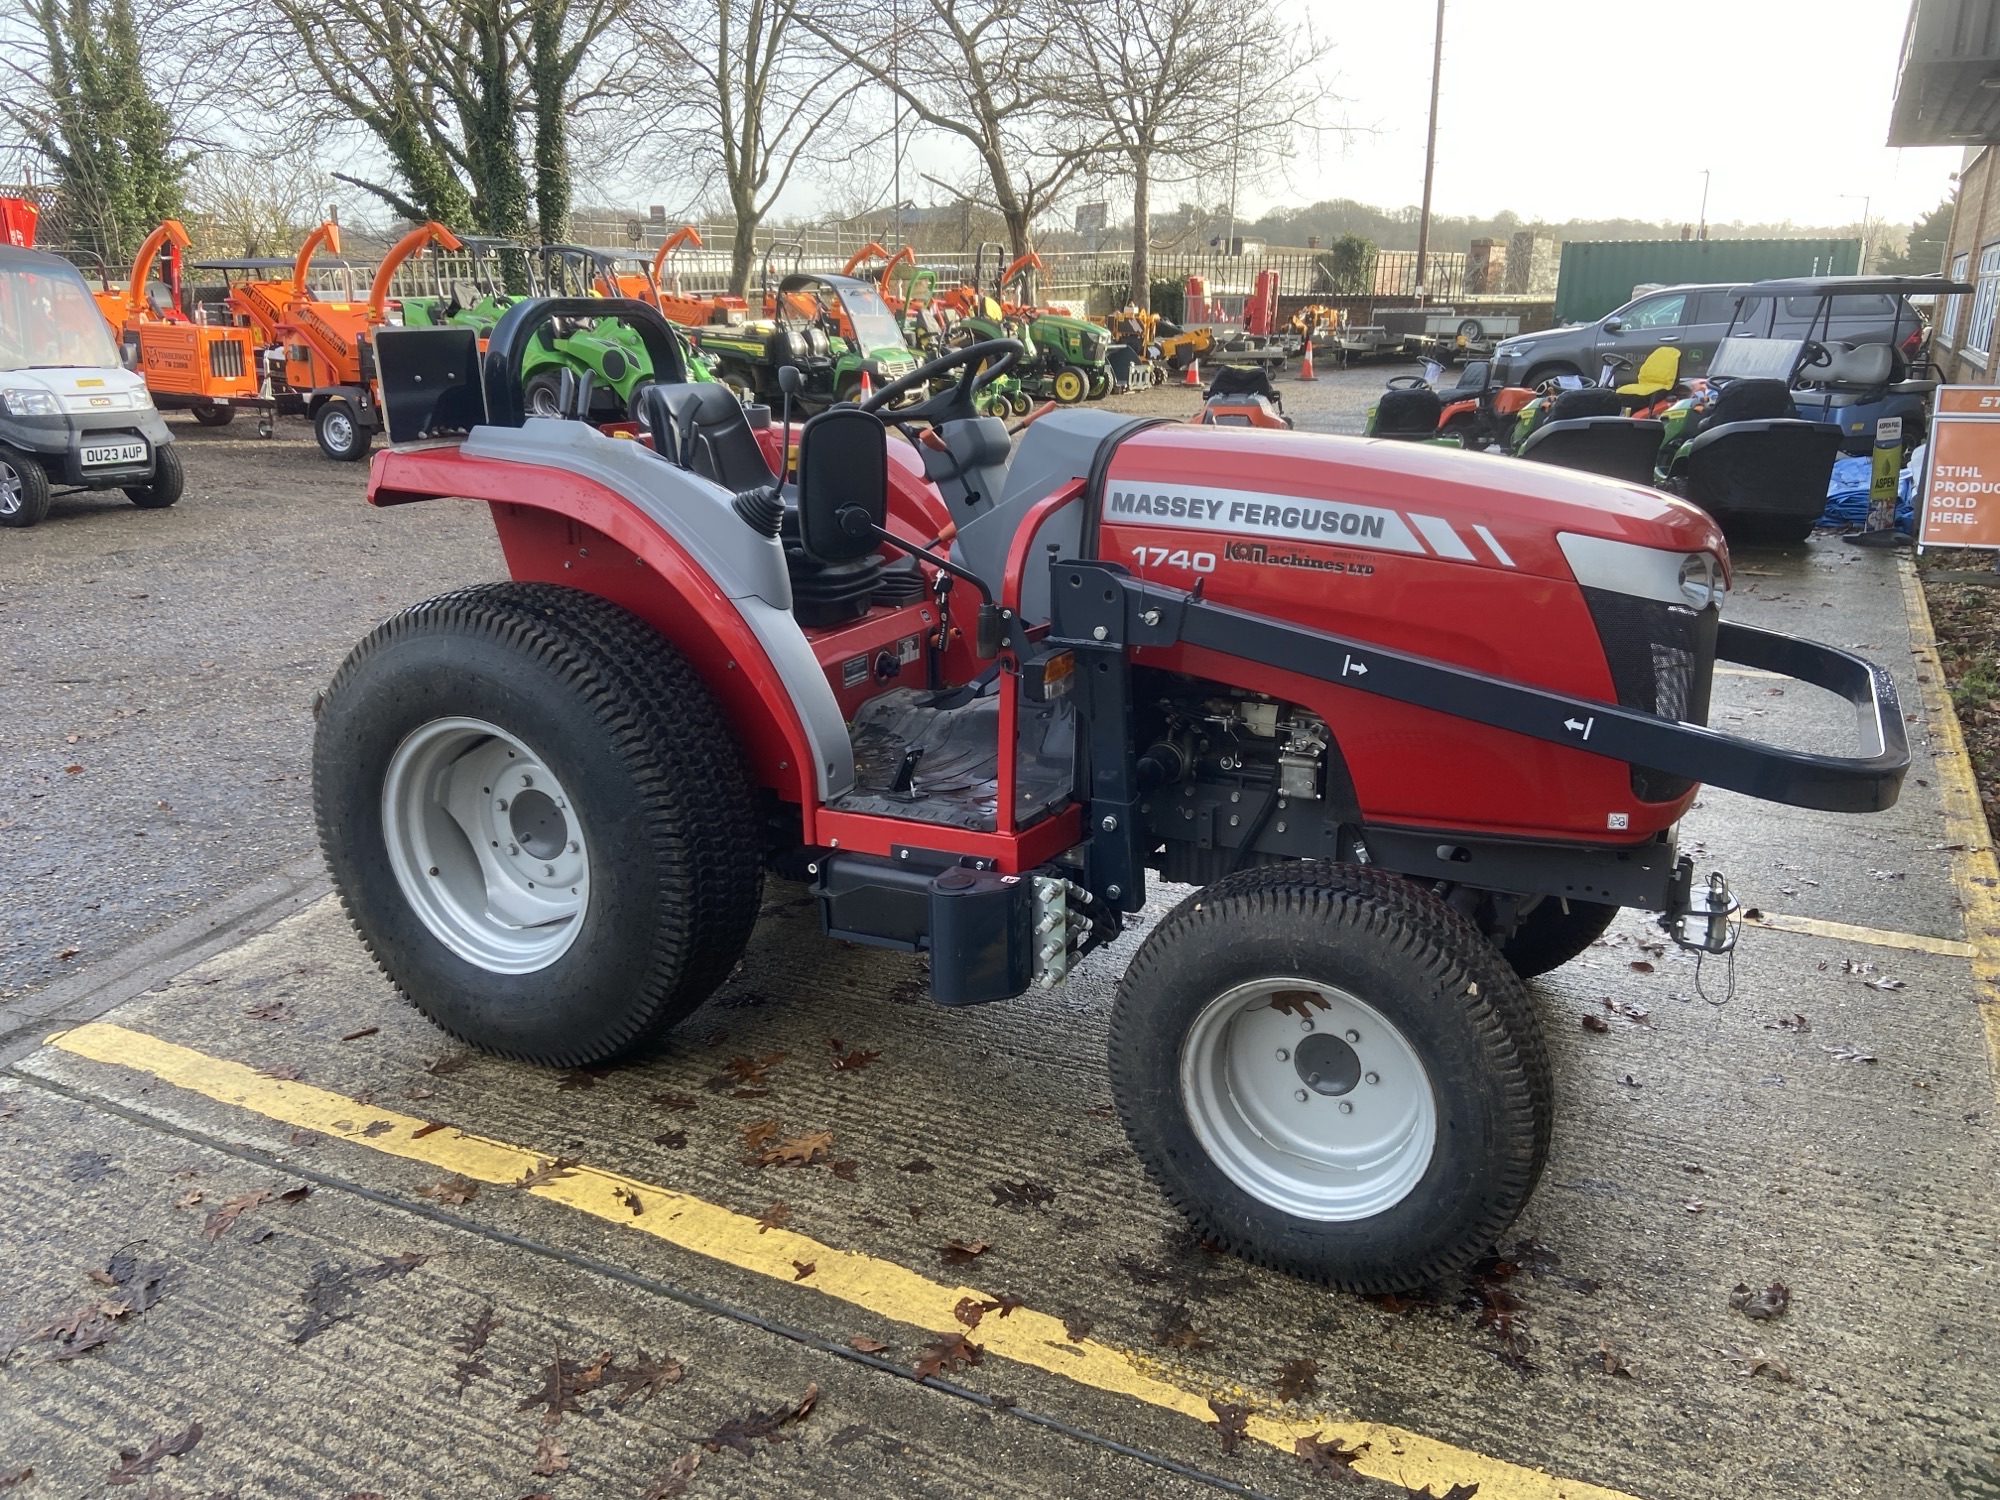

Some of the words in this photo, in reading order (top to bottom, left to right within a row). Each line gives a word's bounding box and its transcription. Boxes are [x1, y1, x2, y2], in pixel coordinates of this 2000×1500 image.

[86, 448, 119, 462] OU23
[122, 446, 142, 459] AUP
[1935, 465, 1983, 478] STIHL
[1875, 477, 1896, 489] ASPEN
[1931, 496, 1977, 509] SOLD
[1111, 492, 1224, 521] MASSEY
[1228, 501, 1386, 540] FERGUSON
[1930, 511, 1979, 525] HERE.
[1131, 546, 1216, 573] 1740
[1346, 562, 1376, 577] LTD
